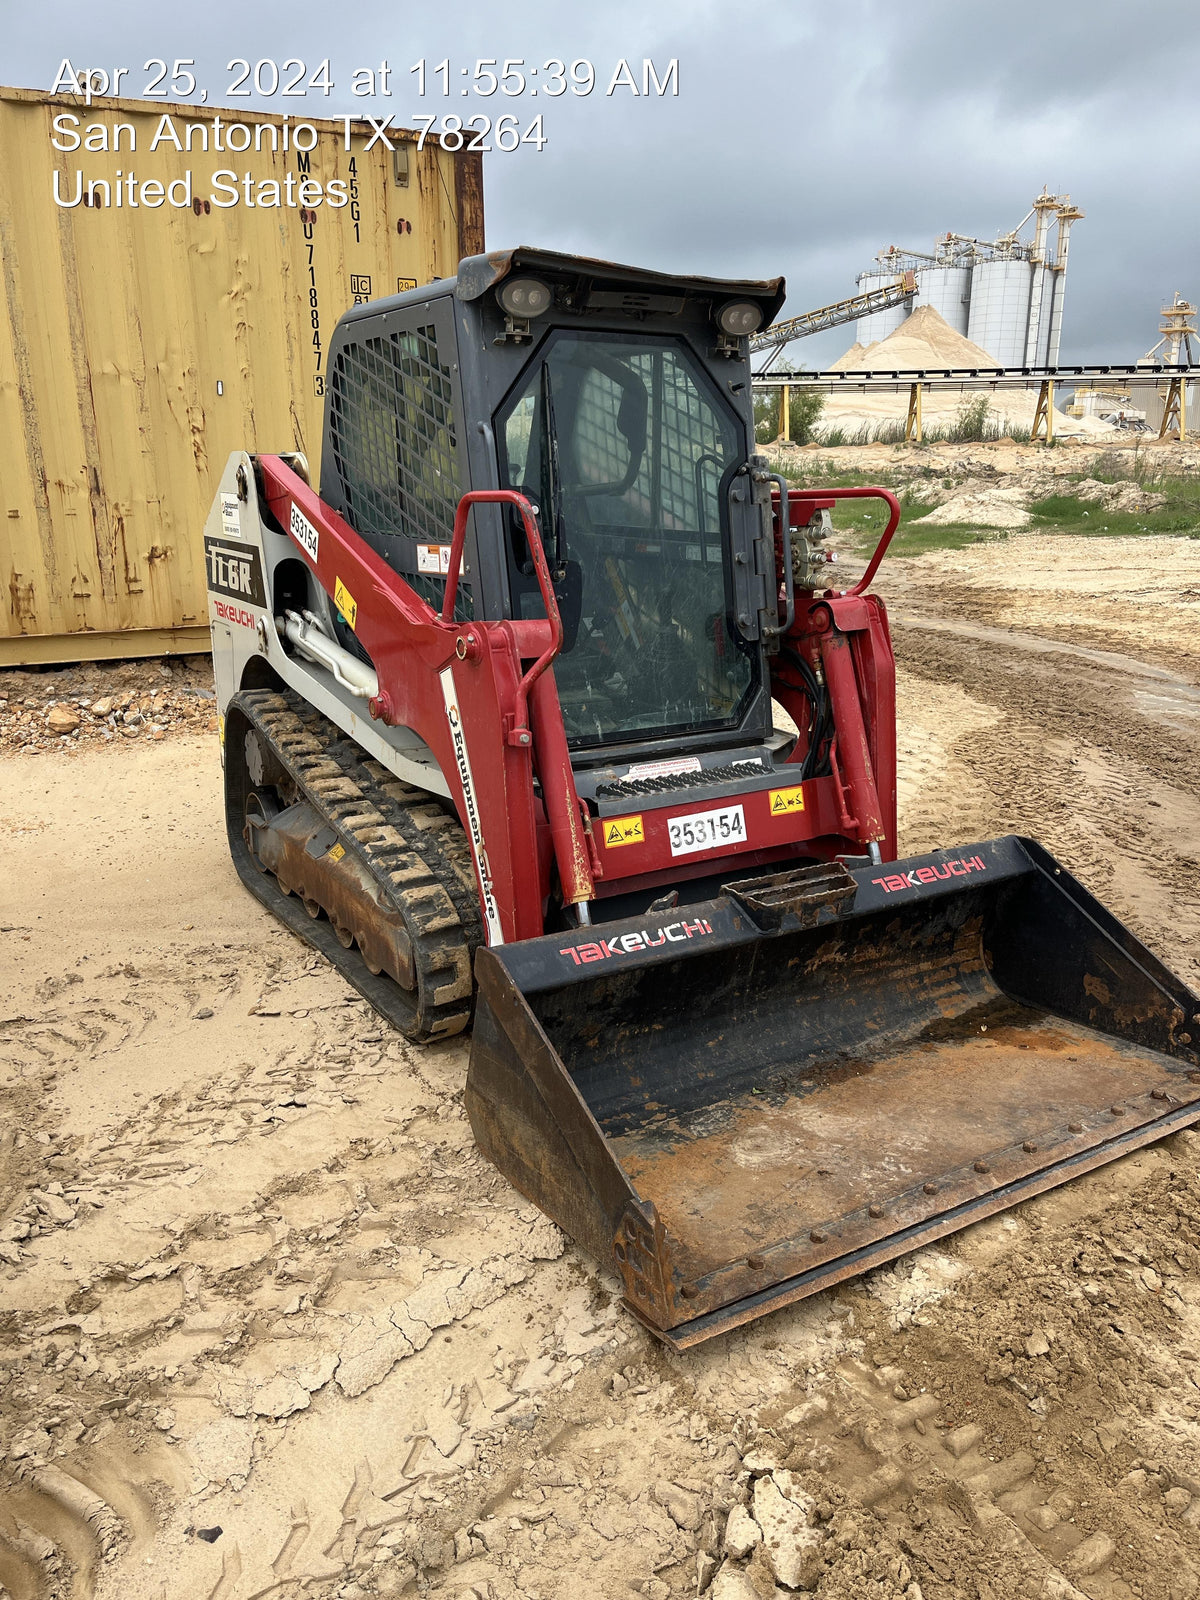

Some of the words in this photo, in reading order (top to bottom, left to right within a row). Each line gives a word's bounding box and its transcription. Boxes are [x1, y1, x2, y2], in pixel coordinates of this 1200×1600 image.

[348, 156, 361, 243] 45G1
[291, 507, 318, 556] 353154
[670, 812, 743, 849] 353154
